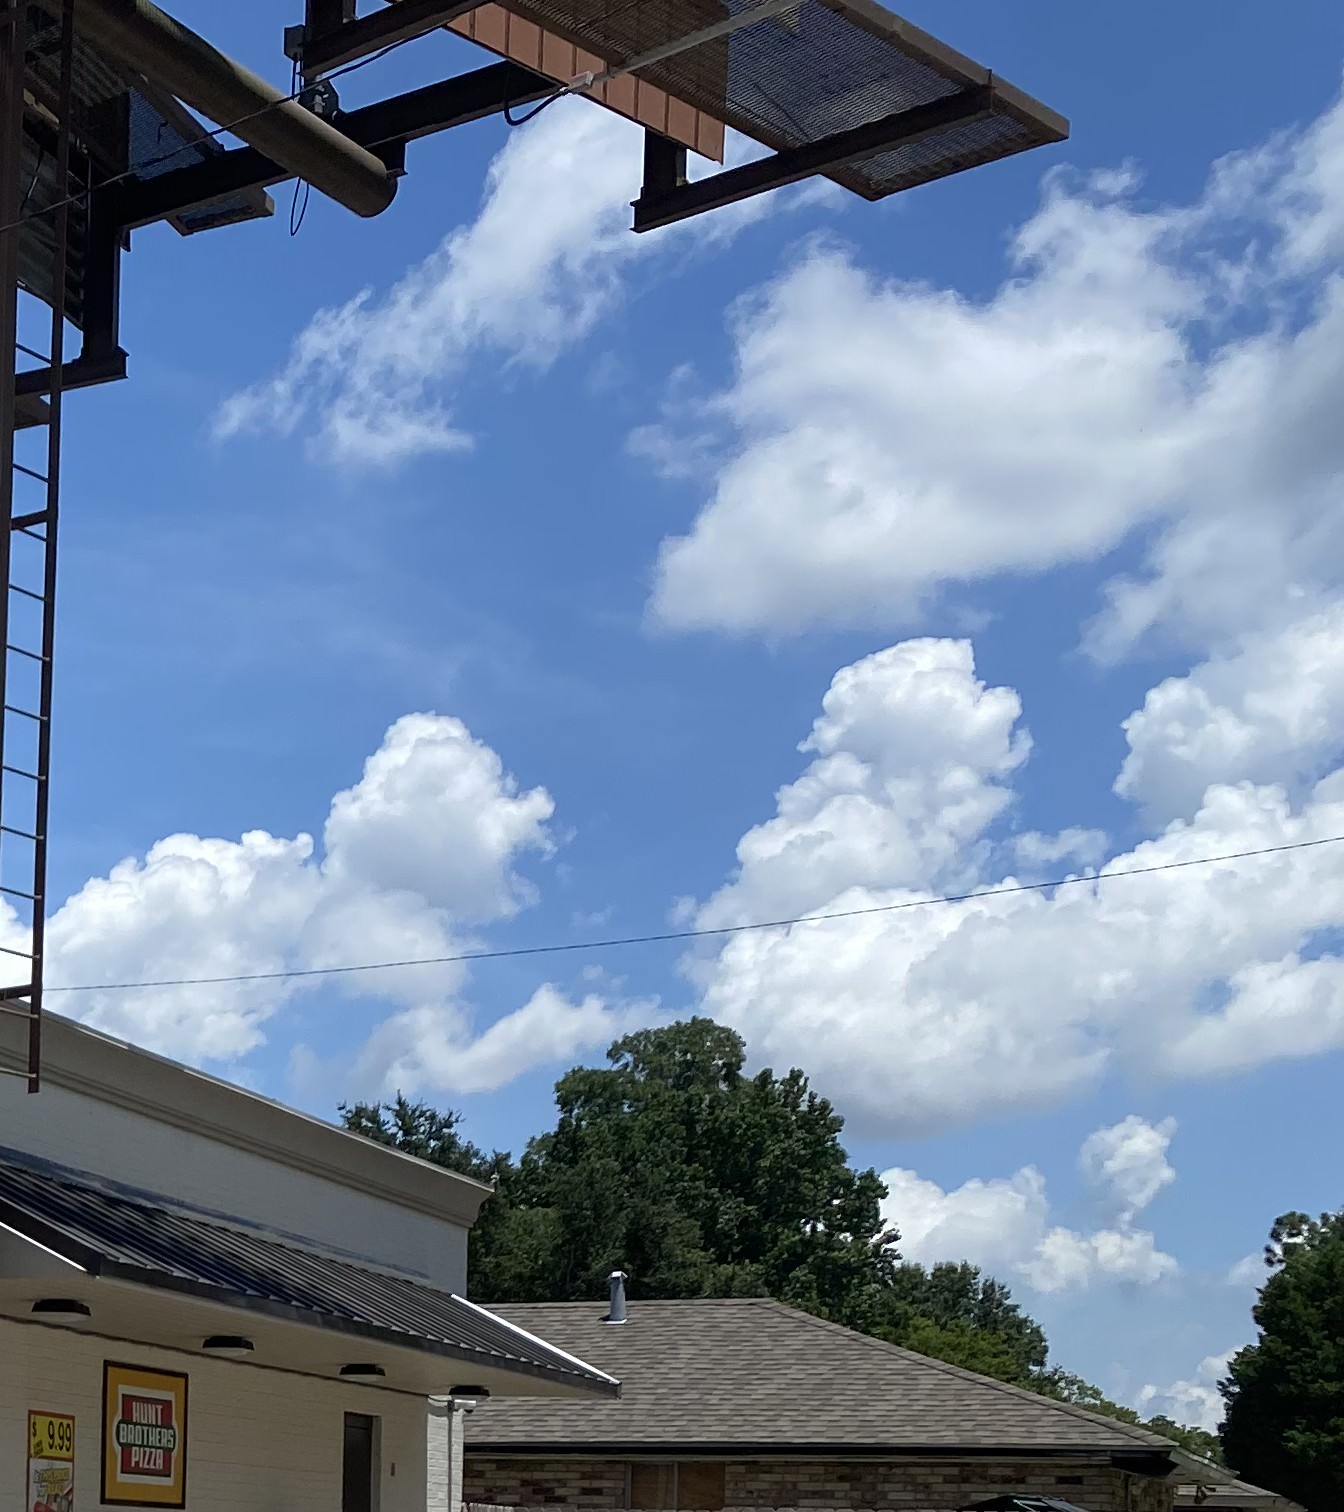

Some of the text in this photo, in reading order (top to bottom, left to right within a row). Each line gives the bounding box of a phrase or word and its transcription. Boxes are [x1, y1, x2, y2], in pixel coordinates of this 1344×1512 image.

[132, 1401, 163, 1425] HUNT
[48, 1420, 72, 1452] 9.99
[119, 1423, 174, 1449] BROTHERS
[131, 1447, 163, 1469] PIZZA
